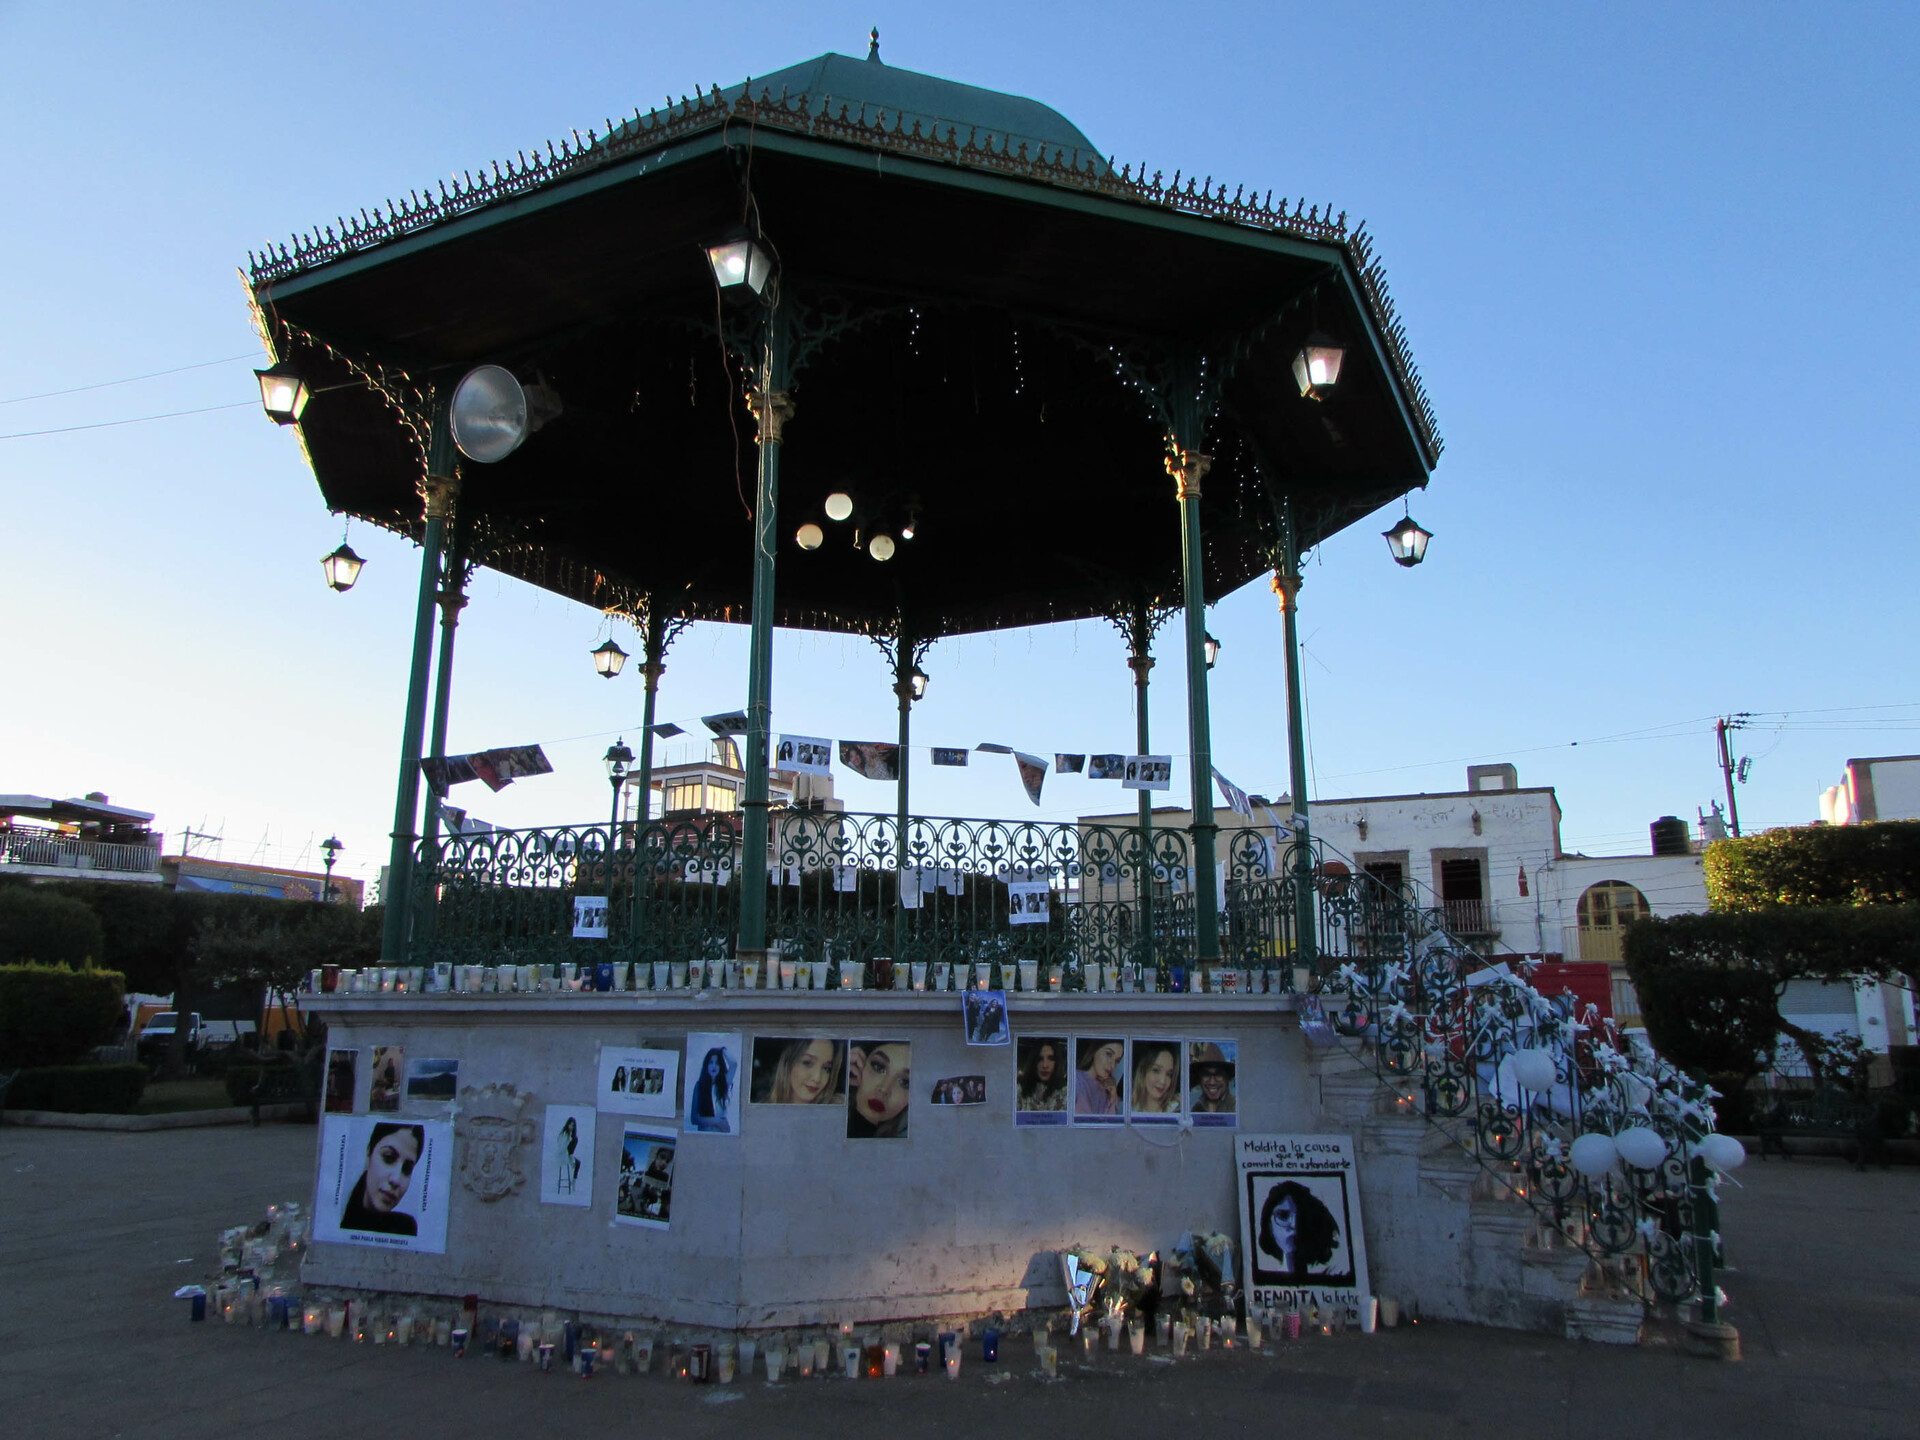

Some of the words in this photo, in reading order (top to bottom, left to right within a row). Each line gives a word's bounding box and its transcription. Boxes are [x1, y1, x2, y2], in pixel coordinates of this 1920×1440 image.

[1244, 1140, 1286, 1152] Maldita
[1291, 1139, 1301, 1152] la
[1304, 1143, 1340, 1153] causa
[1322, 1291, 1332, 1303] la
